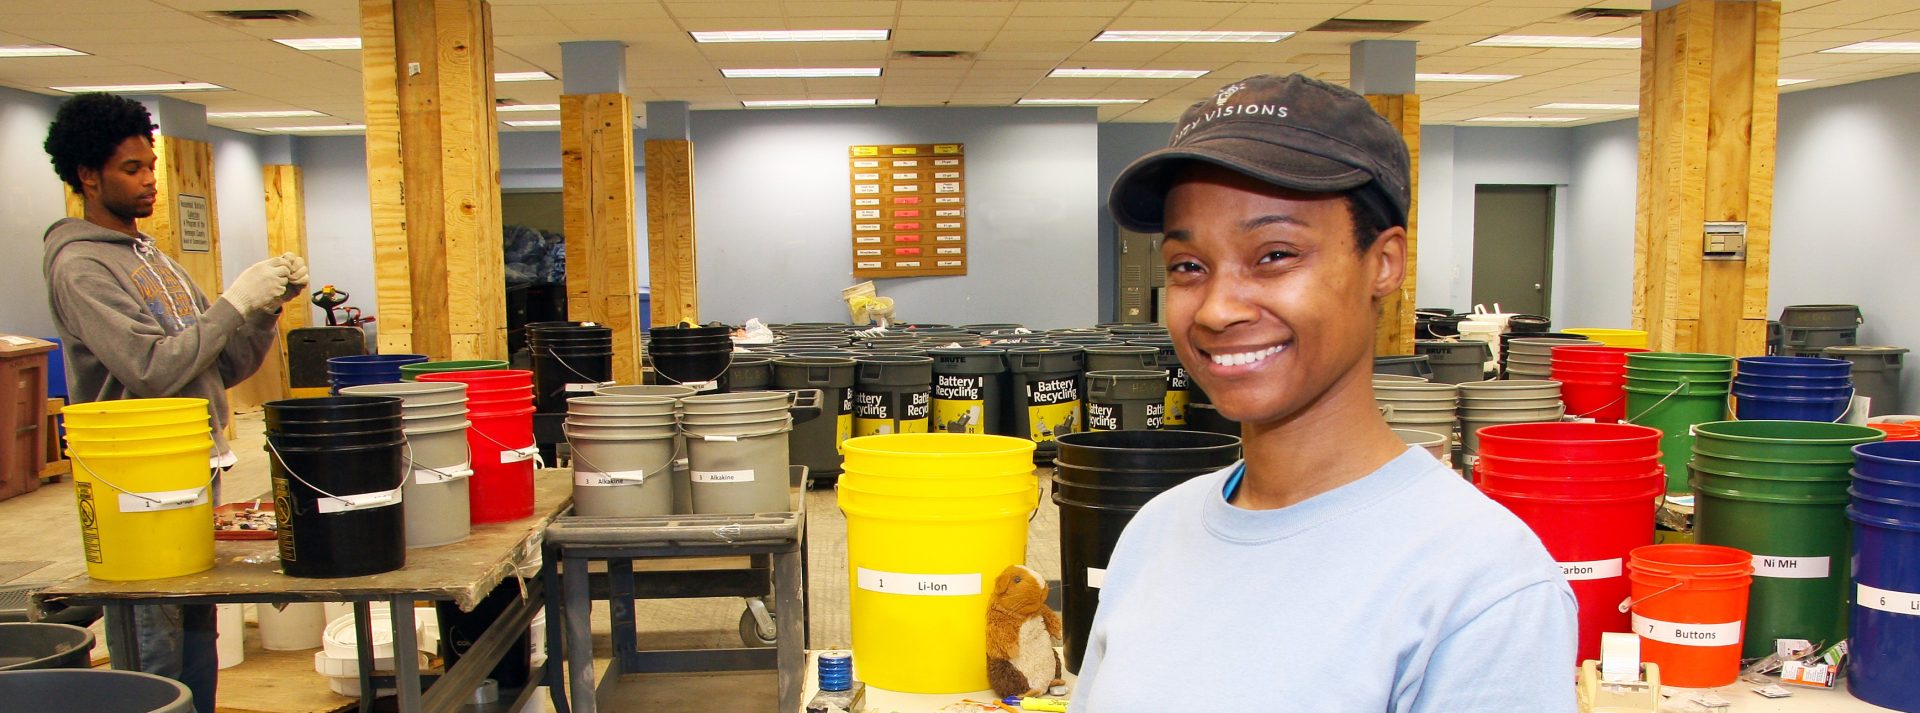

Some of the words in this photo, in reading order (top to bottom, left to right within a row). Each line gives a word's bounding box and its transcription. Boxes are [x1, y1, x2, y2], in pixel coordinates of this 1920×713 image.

[1205, 104, 1288, 121] VISIONS
[938, 375, 974, 390] Battery
[1038, 379, 1074, 393] Battery
[935, 385, 979, 400] Recycling
[1033, 388, 1077, 404] Recycling
[1559, 565, 1593, 575] arbon
[1763, 559, 1776, 568] Ni
[1778, 559, 1798, 569] MH
[880, 578, 884, 588] 1
[918, 581, 948, 591] Li-Ion
[1880, 596, 1886, 606] 6
[1649, 624, 1655, 634] 7
[1675, 629, 1717, 640] Buttons
